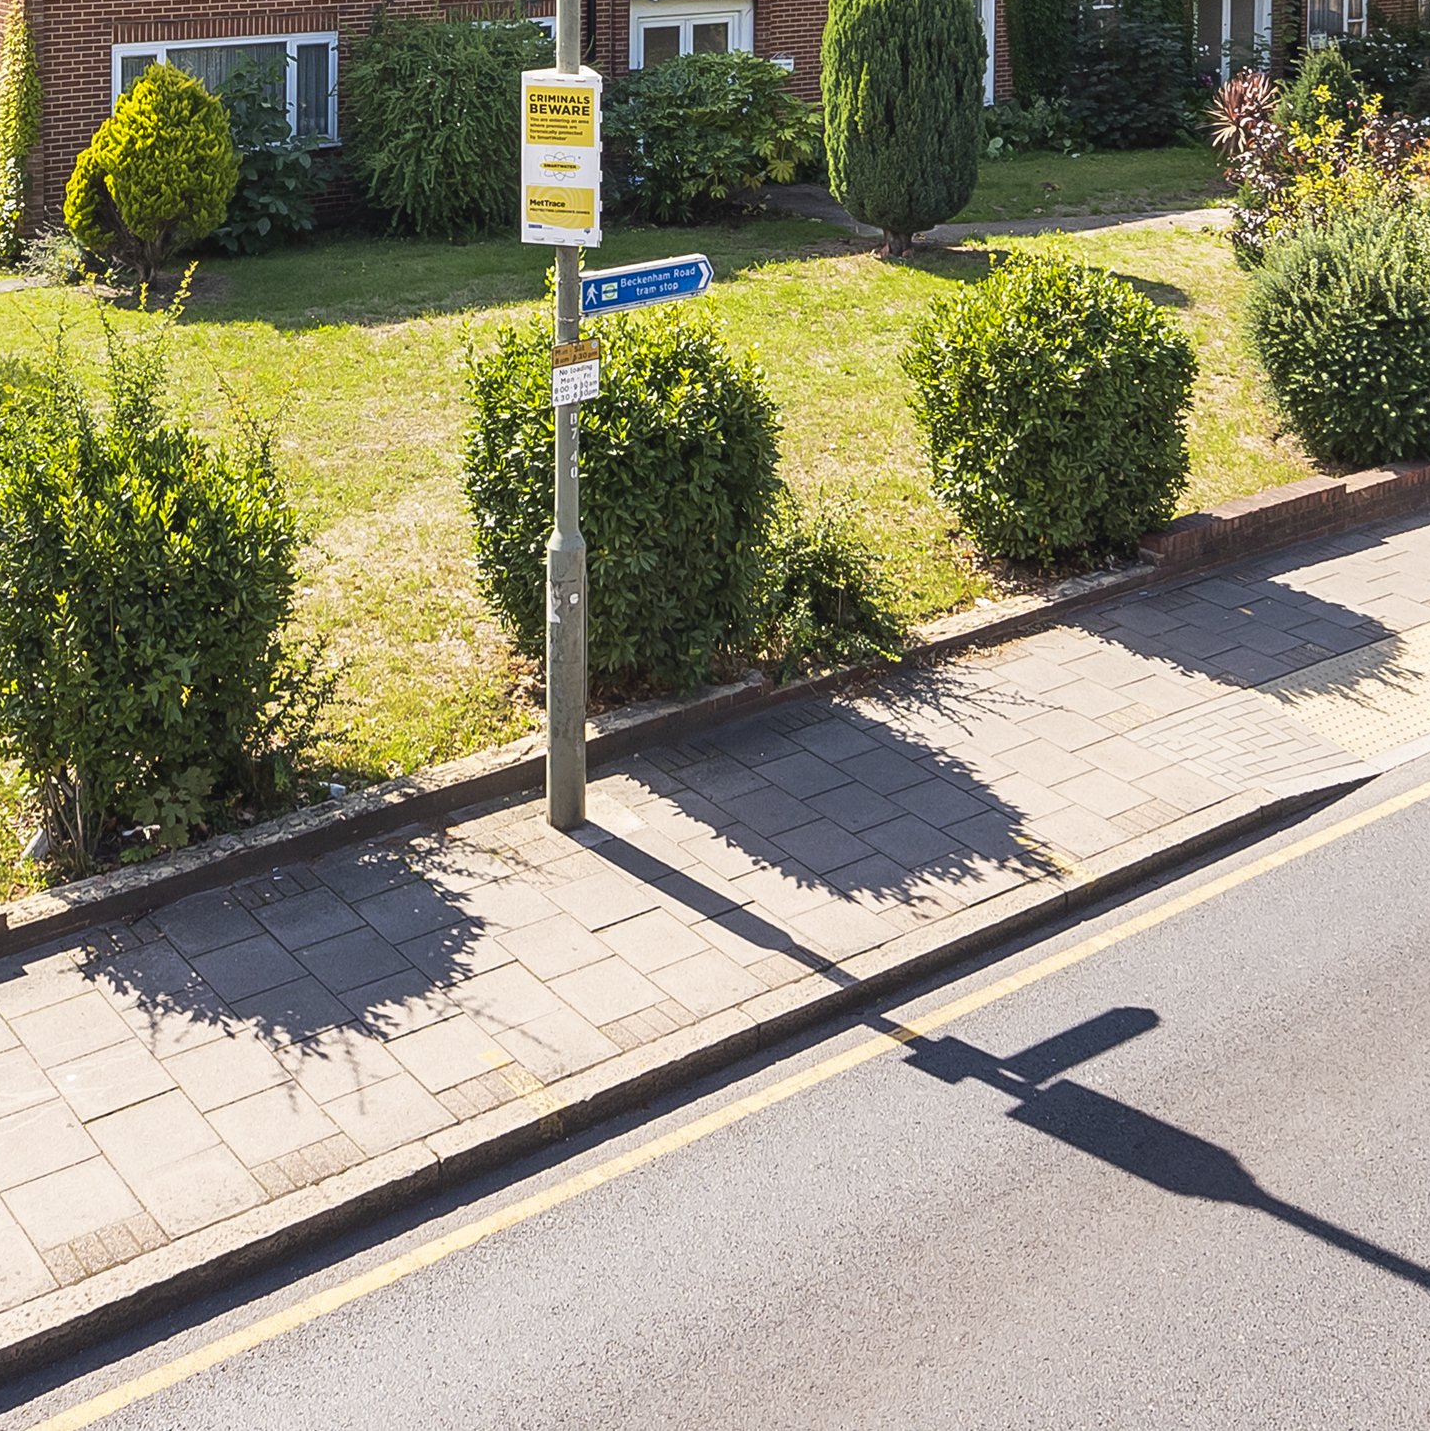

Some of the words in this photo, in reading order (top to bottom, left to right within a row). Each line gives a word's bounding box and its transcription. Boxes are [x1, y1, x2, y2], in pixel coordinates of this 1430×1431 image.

[529, 94, 590, 104] CRIMINALS
[529, 104, 590, 116] BEWARE
[529, 199, 566, 208] MetTrace
[620, 271, 670, 288] Beckenham
[673, 266, 695, 278] Road
[636, 286, 656, 296] tram
[659, 281, 679, 292] stop
